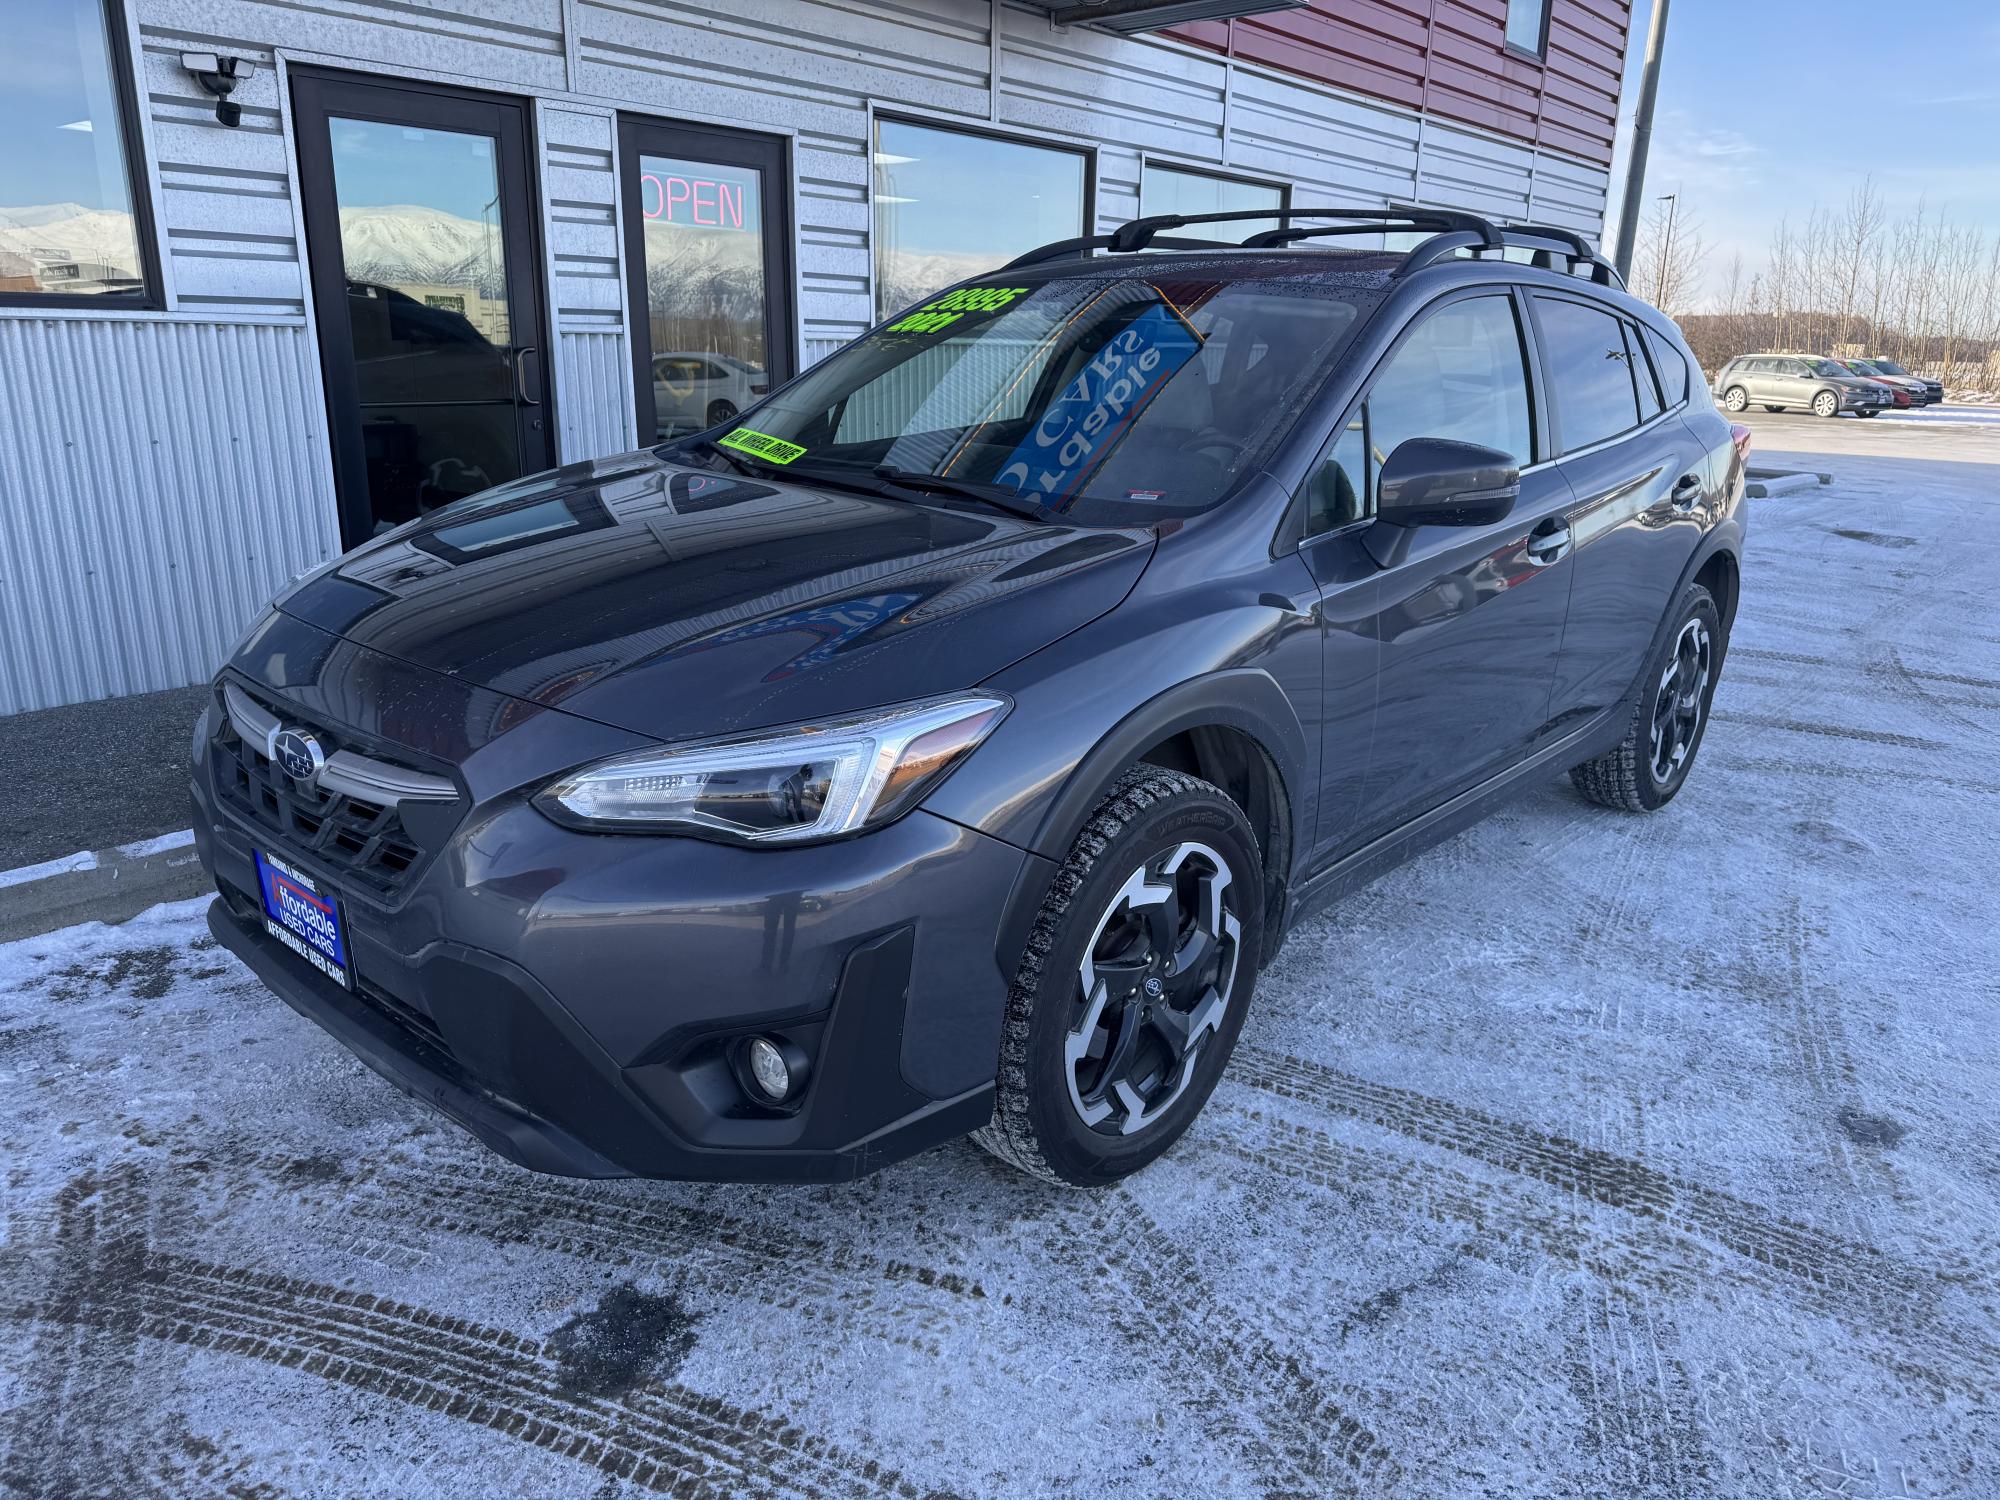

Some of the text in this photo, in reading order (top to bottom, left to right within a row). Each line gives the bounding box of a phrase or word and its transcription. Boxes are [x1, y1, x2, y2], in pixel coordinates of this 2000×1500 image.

[641, 175, 743, 229] OPEN
[886, 312, 965, 333] 2021
[920, 288, 1029, 311] 28995
[722, 430, 802, 462] ALL WHEEL DRIVE
[271, 872, 336, 941] Affordable
[267, 919, 346, 987] AFFORDABLE USED CARS
[280, 908, 335, 957] USED CARS
